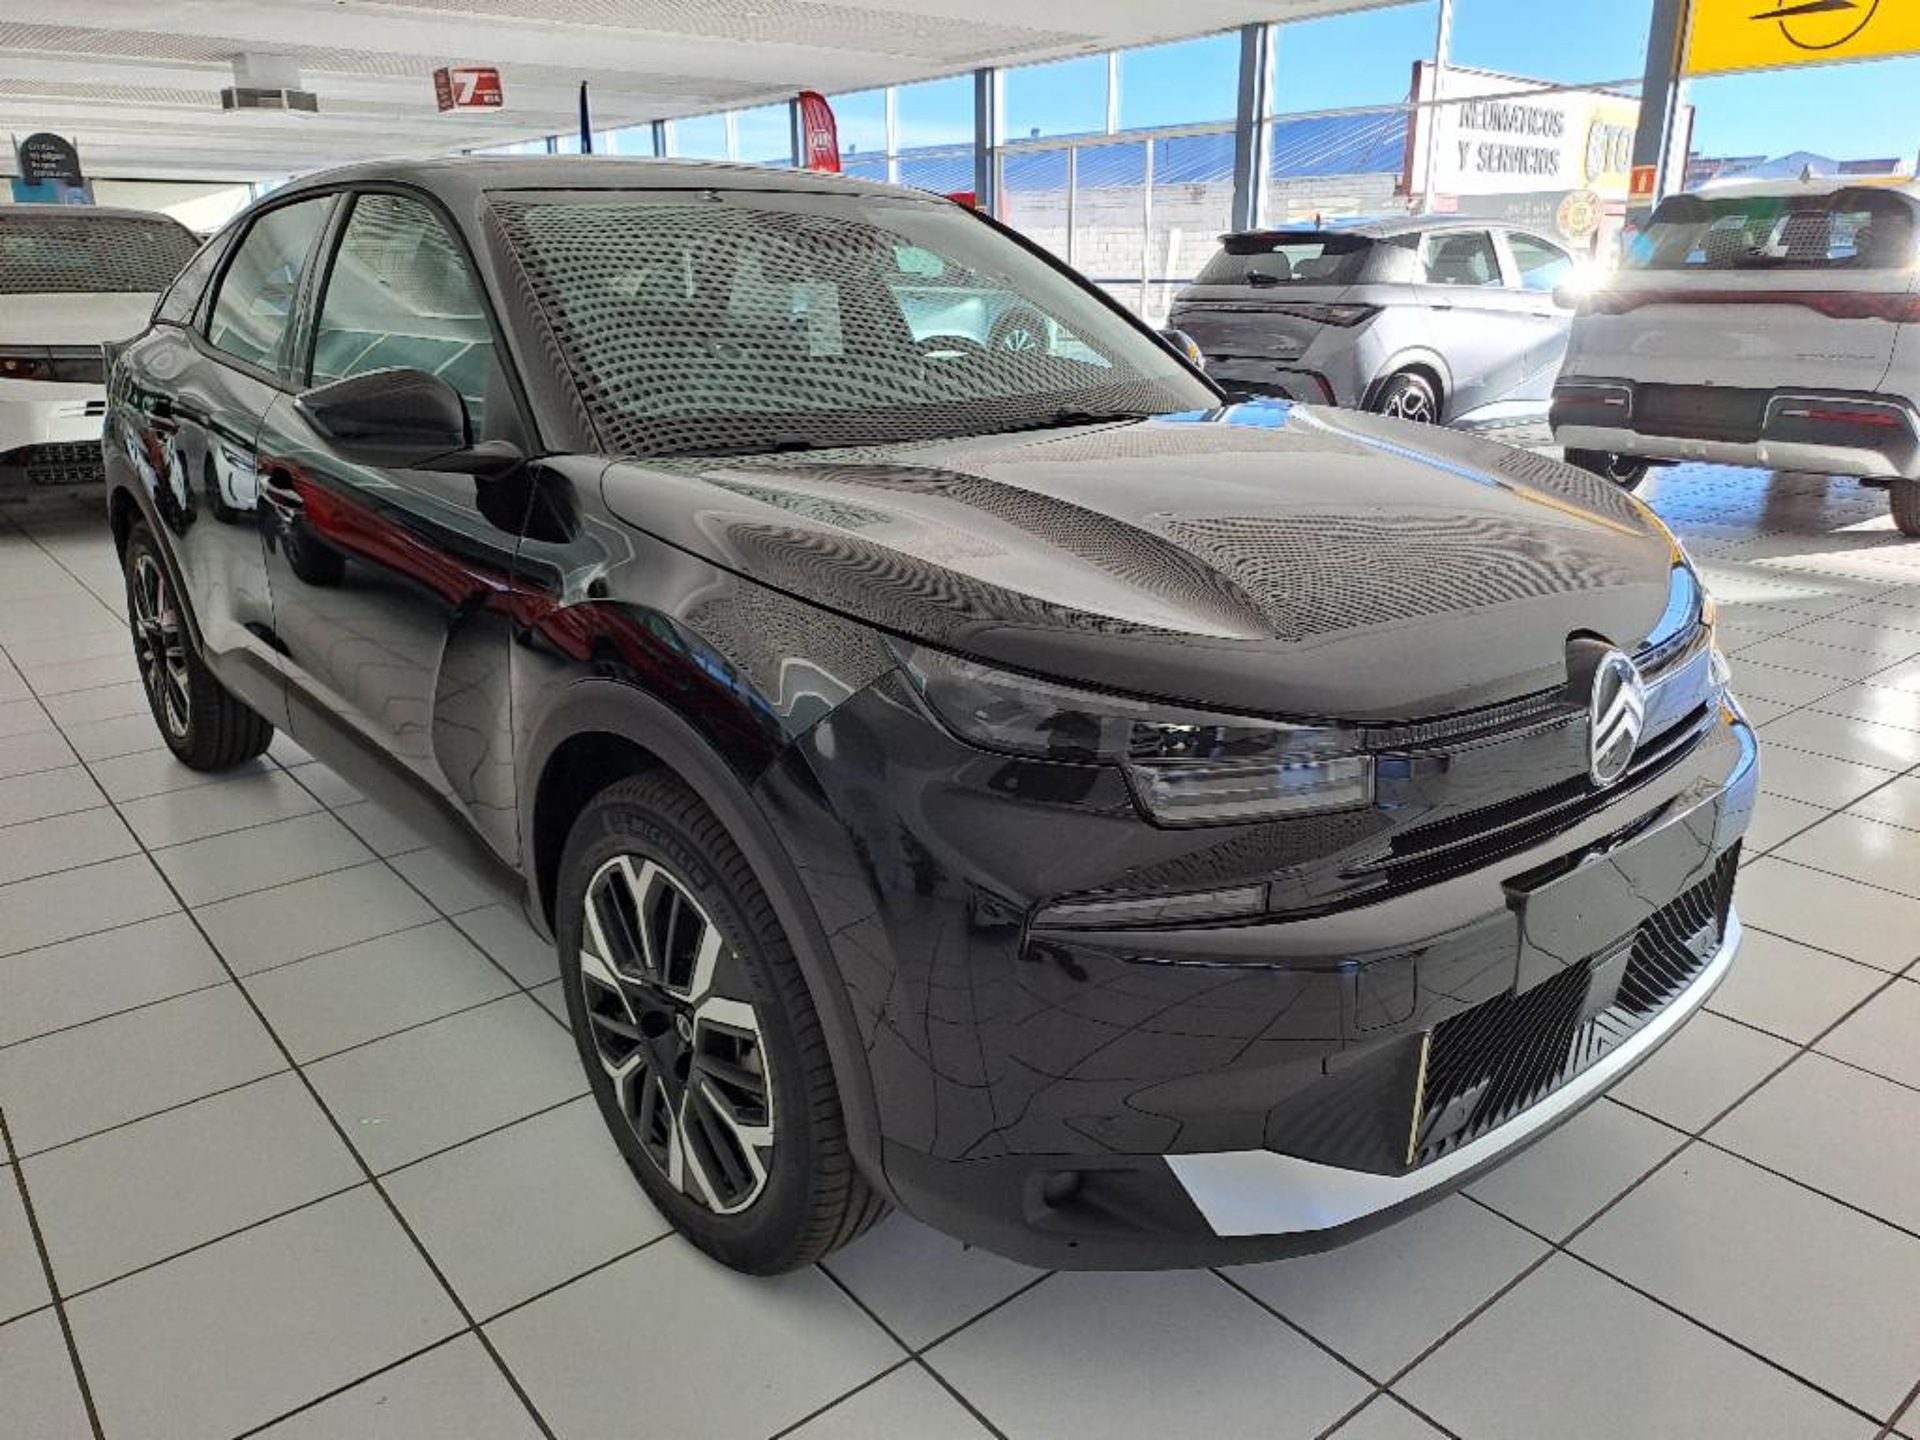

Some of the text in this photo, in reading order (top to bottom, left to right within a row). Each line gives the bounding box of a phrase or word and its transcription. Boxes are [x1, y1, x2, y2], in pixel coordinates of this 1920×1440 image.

[453, 72, 479, 105] 7
[1458, 140, 1561, 177] Y SERVICIOS
